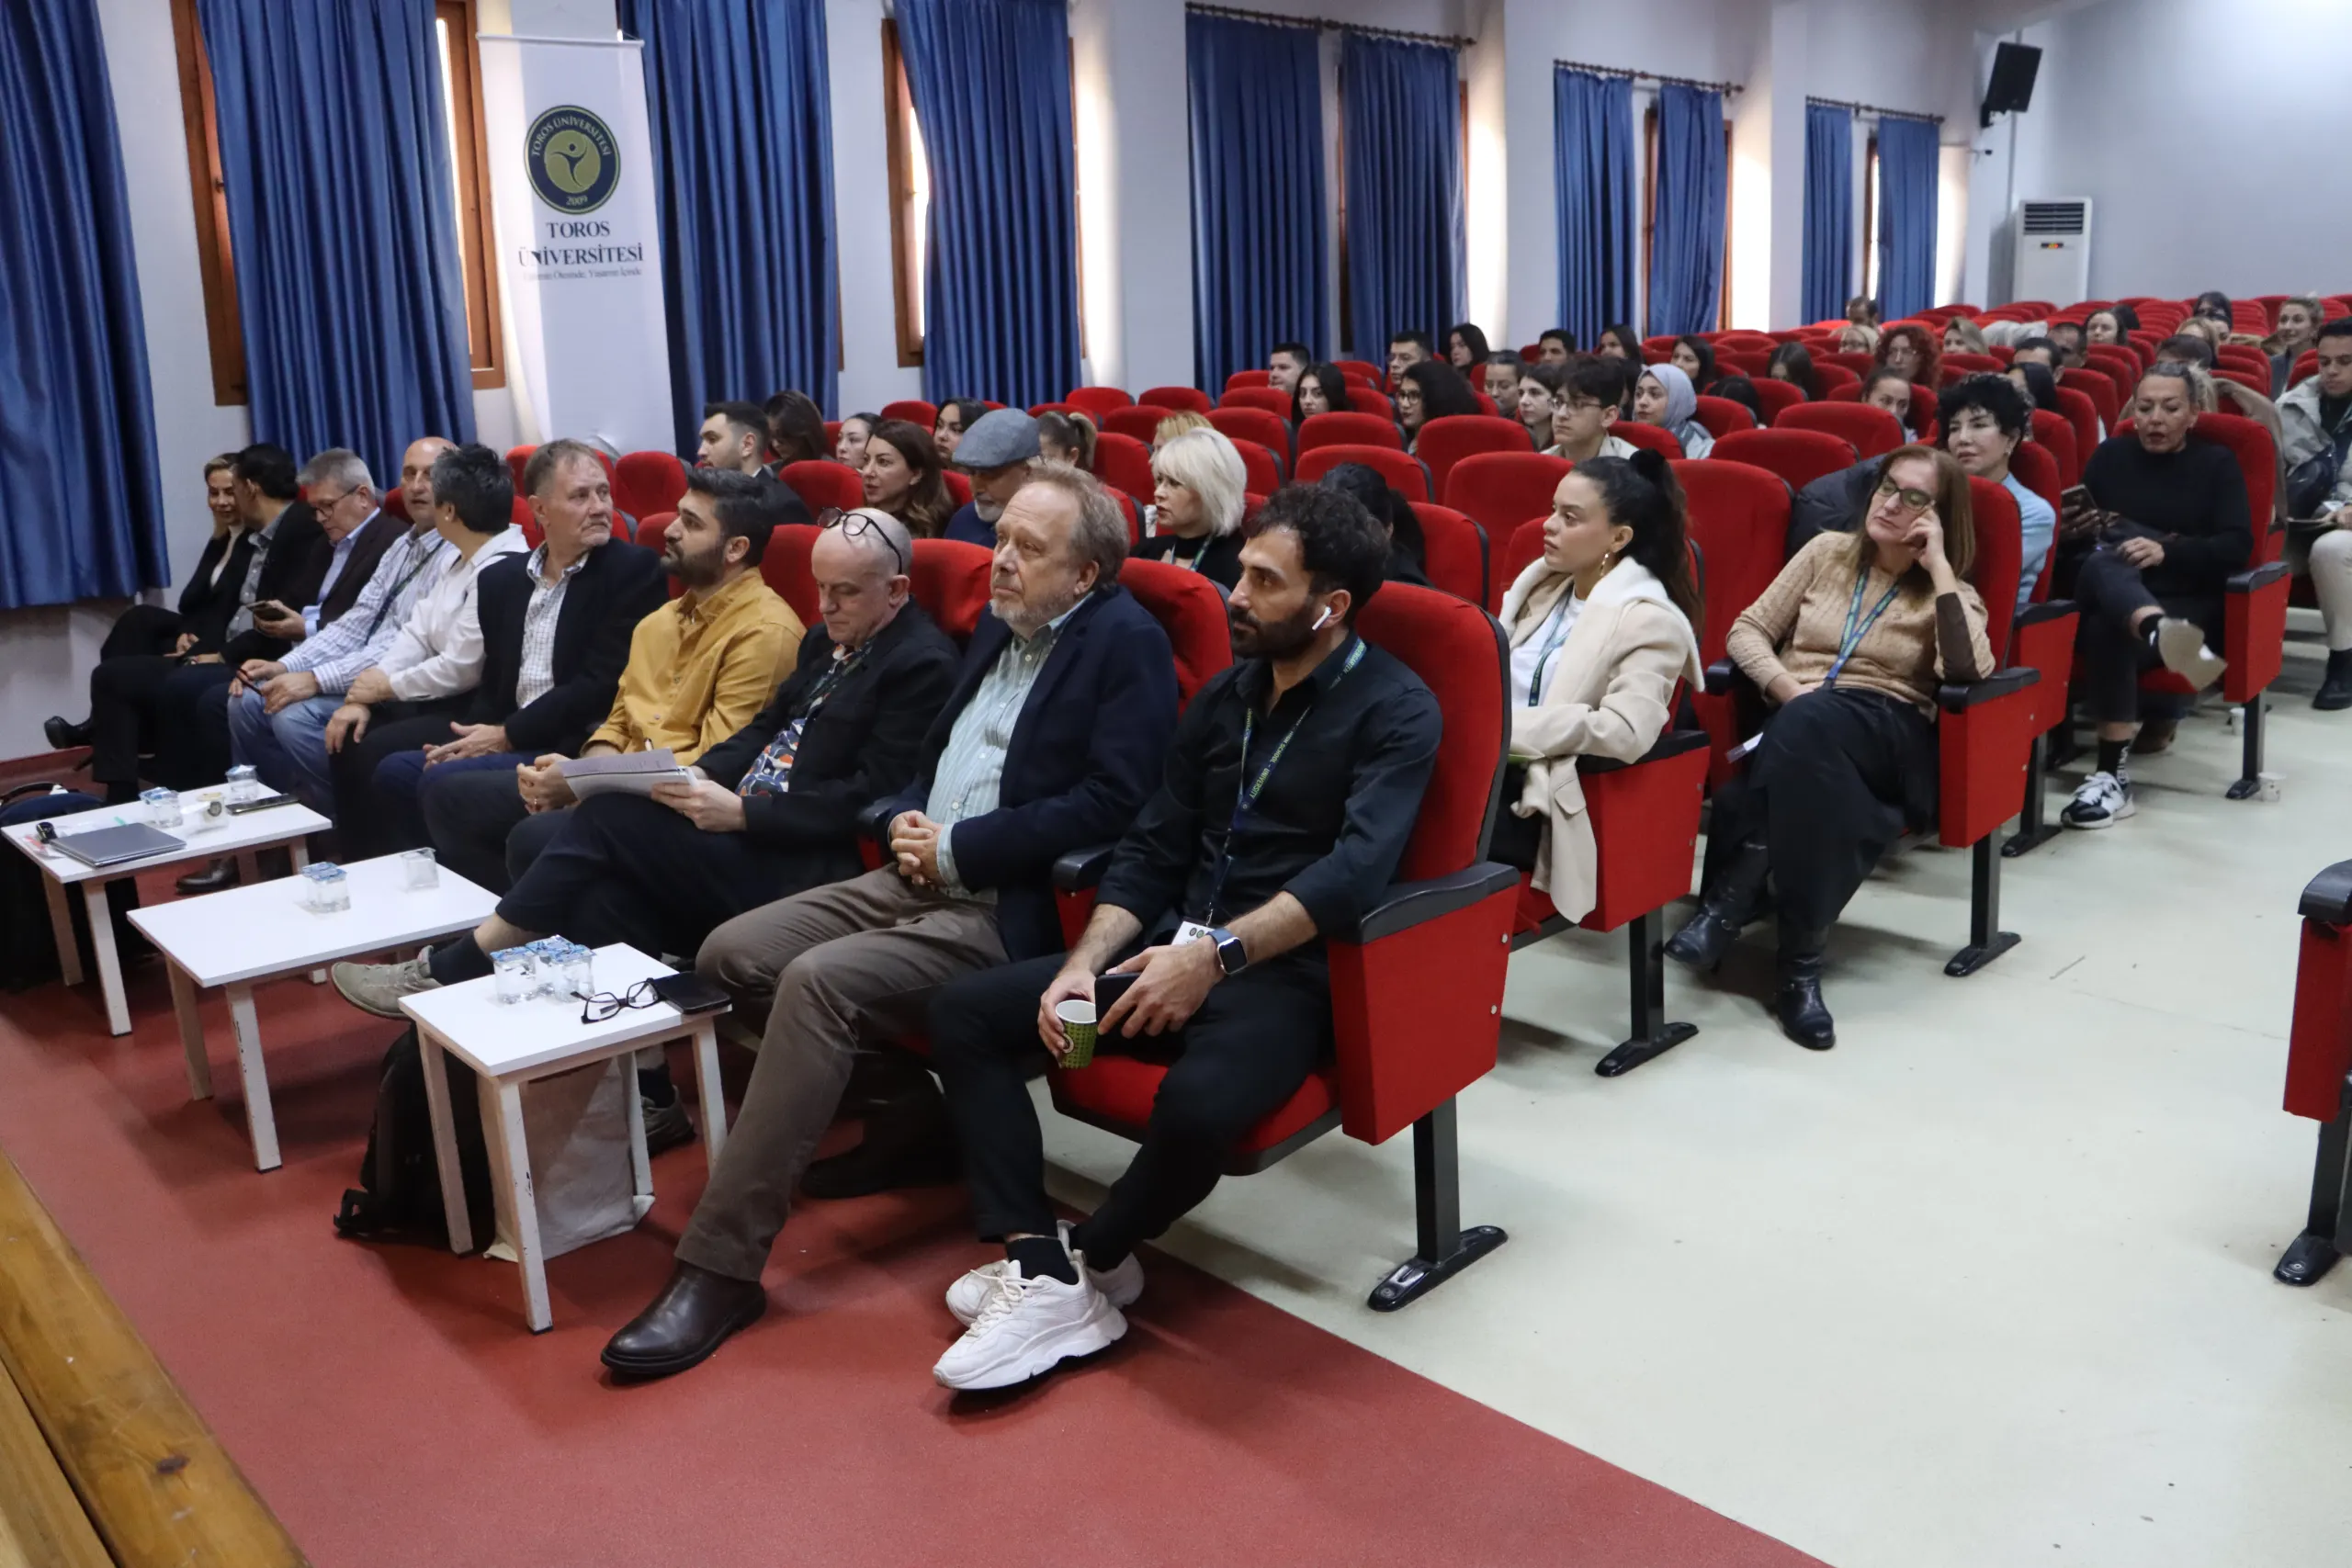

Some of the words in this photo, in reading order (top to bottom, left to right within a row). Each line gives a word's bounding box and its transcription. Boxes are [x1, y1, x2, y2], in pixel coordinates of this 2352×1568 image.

[531, 121, 554, 157] TOROS
[553, 115, 611, 156] ÜNİVERSİTESİ
[566, 194, 589, 206] 2009
[546, 220, 611, 239] TOROS
[518, 242, 643, 266] ÜNİVERSİTESİ
[1249, 767, 1270, 799] UNIVERSITY
